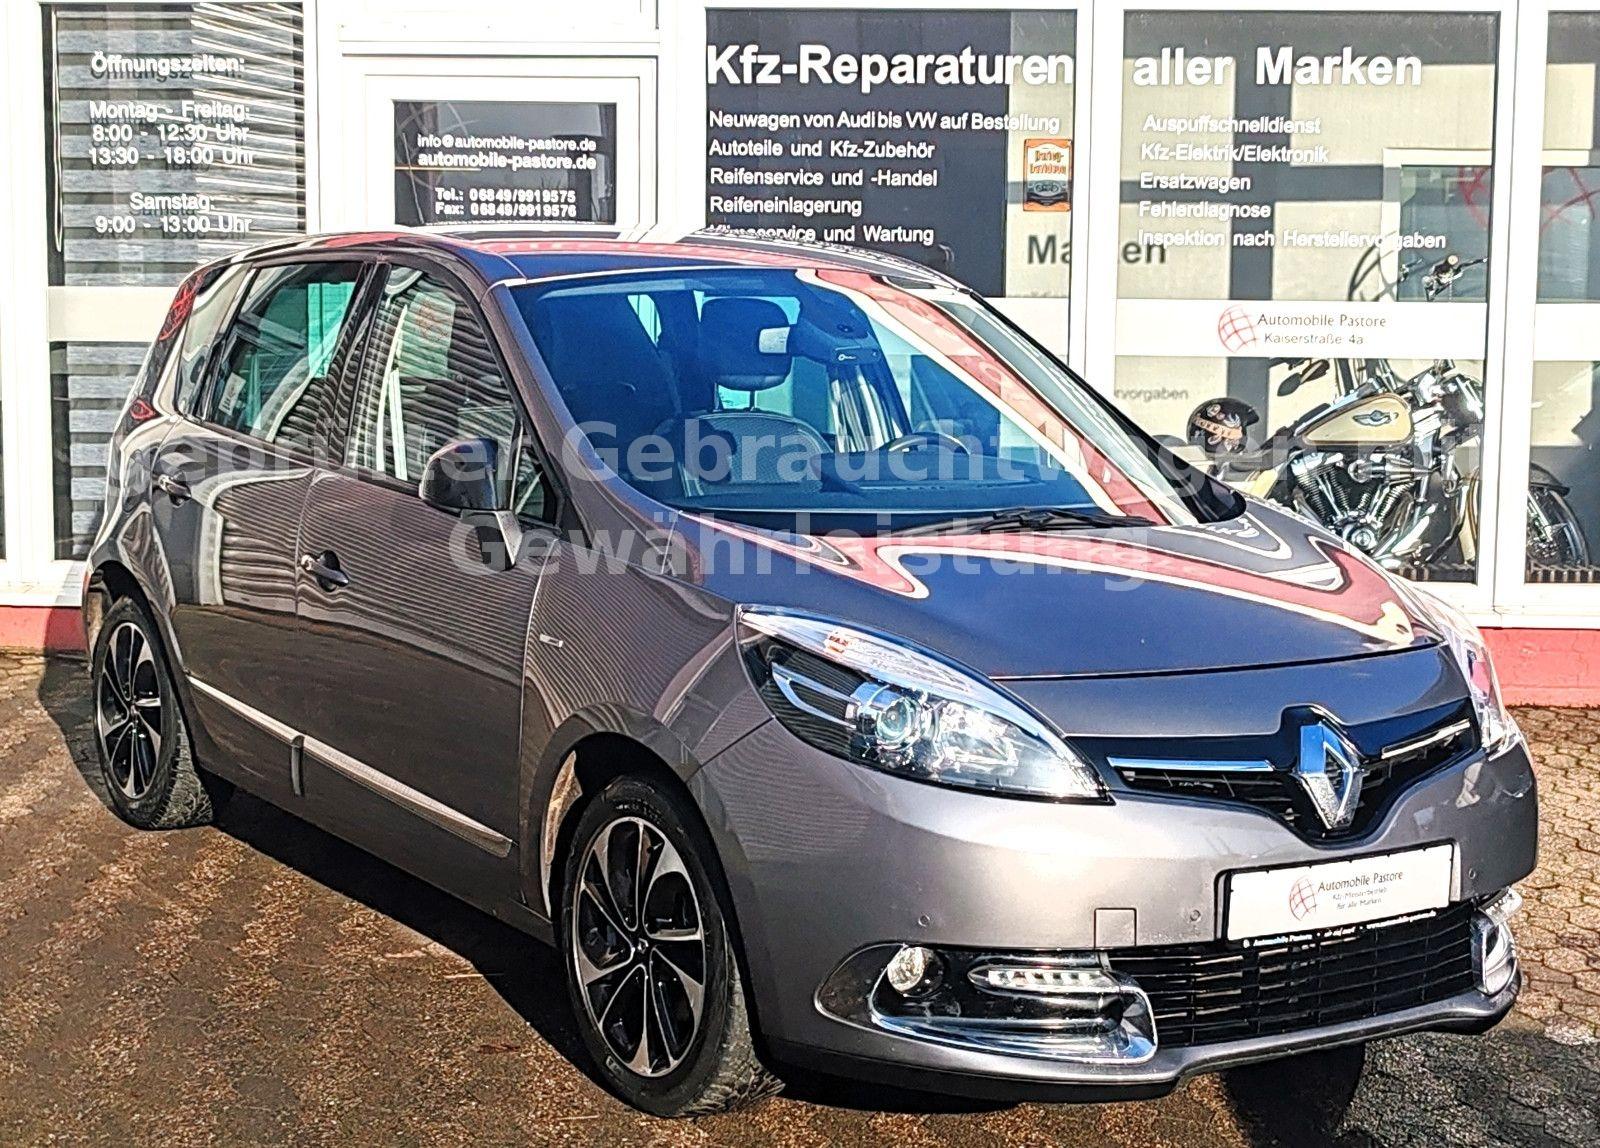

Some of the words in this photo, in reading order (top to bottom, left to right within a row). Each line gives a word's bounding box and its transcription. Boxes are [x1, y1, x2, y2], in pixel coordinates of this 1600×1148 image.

[91, 51, 245, 76] Öffnungszeiten:
[706, 44, 1073, 93] Kfz-Reparaturen
[1133, 46, 1232, 87] aller
[1256, 46, 1422, 86] Marken
[89, 101, 161, 122] Montag
[181, 101, 251, 122] Freitag:
[708, 110, 801, 131] Neuwagen
[803, 114, 834, 129] von
[836, 112, 876, 129] Audi
[877, 112, 902, 129] bis
[905, 112, 938, 129] VW
[939, 112, 968, 130] auf
[971, 113, 1060, 134] Bestellung
[1142, 114, 1322, 135] Auspuffschnelldienst
[92, 124, 133, 142] 8:00
[157, 124, 208, 142] 12:30
[216, 125, 250, 142] Uhr
[417, 133, 597, 152] info@automobile-pastore.de
[89, 147, 139, 165] 13:30
[163, 147, 214, 165] 18:00
[221, 148, 253, 165] Uhr
[709, 140, 783, 157] Autoteile
[790, 140, 823, 157] und
[830, 140, 936, 159] Kfz-Zubehör
[1141, 144, 1329, 163] Kfz-Elektrik/Elektronik
[417, 152, 597, 171] automobile-pastore.de
[710, 168, 824, 186] Reifenservice
[831, 169, 863, 186] und
[870, 170, 938, 187] -Handel
[1139, 173, 1251, 194] Ersatzwagen
[129, 192, 215, 213] Samstag:
[435, 187, 464, 201] Tel.:
[435, 203, 465, 215] Fax:
[710, 197, 863, 216] Reifeneinlagerung
[1138, 201, 1271, 222] Fehlerdiagnose
[95, 215, 136, 233] 9:00
[160, 215, 211, 233] 13:00
[217, 216, 252, 233] Uhr
[708, 225, 816, 241] aservice
[824, 225, 855, 242] und
[863, 225, 935, 245] Wartung
[1137, 229, 1225, 249] Inspektion
[1233, 230, 1275, 247] nach
[1283, 231, 1447, 250] Herstellervogaben
[1257, 313, 1335, 326] Automobile
[1340, 314, 1387, 327] Pastore
[1264, 333, 1343, 345] Kaiserstraße
[1348, 334, 1364, 345] 4a
[1317, 876, 1370, 893] Automobile
[1373, 871, 1404, 884] Pastore
